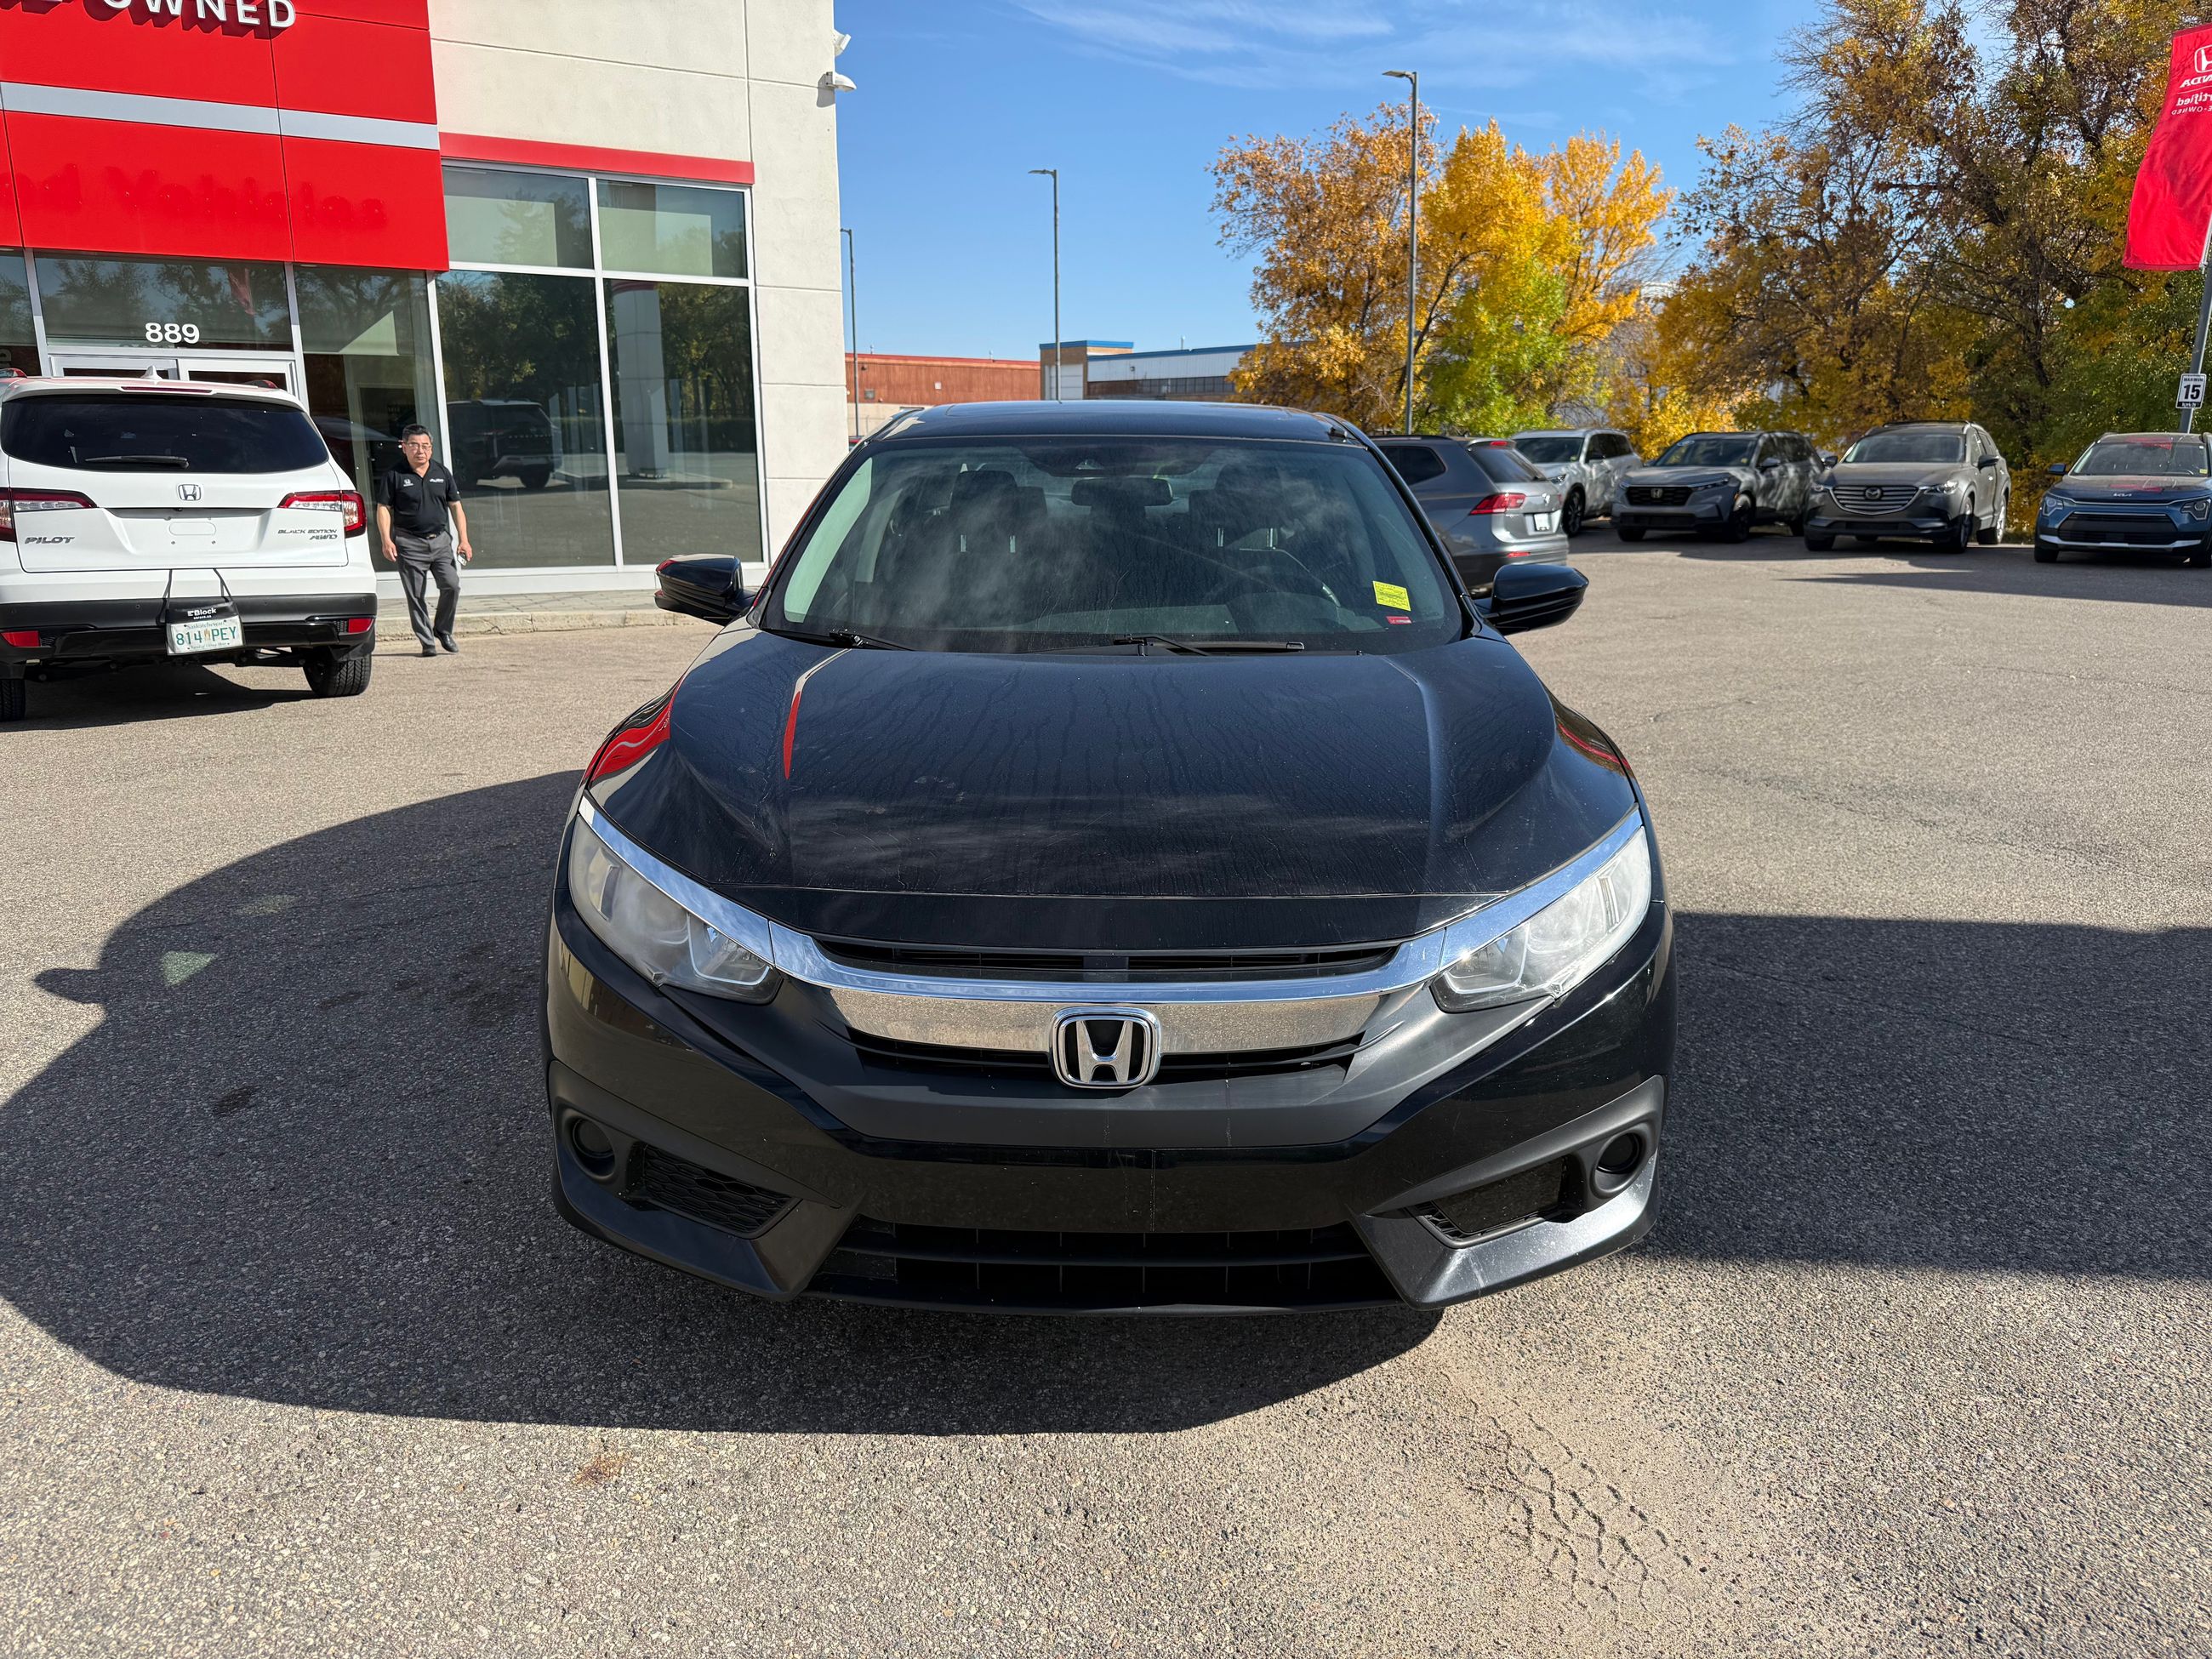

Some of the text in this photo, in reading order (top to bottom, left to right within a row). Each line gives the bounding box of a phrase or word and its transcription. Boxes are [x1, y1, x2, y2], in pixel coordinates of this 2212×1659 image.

[145, 322, 200, 344] 889
[2183, 384, 2201, 400] 15
[25, 536, 75, 544] PILOT
[175, 626, 237, 646] 814 PEY
